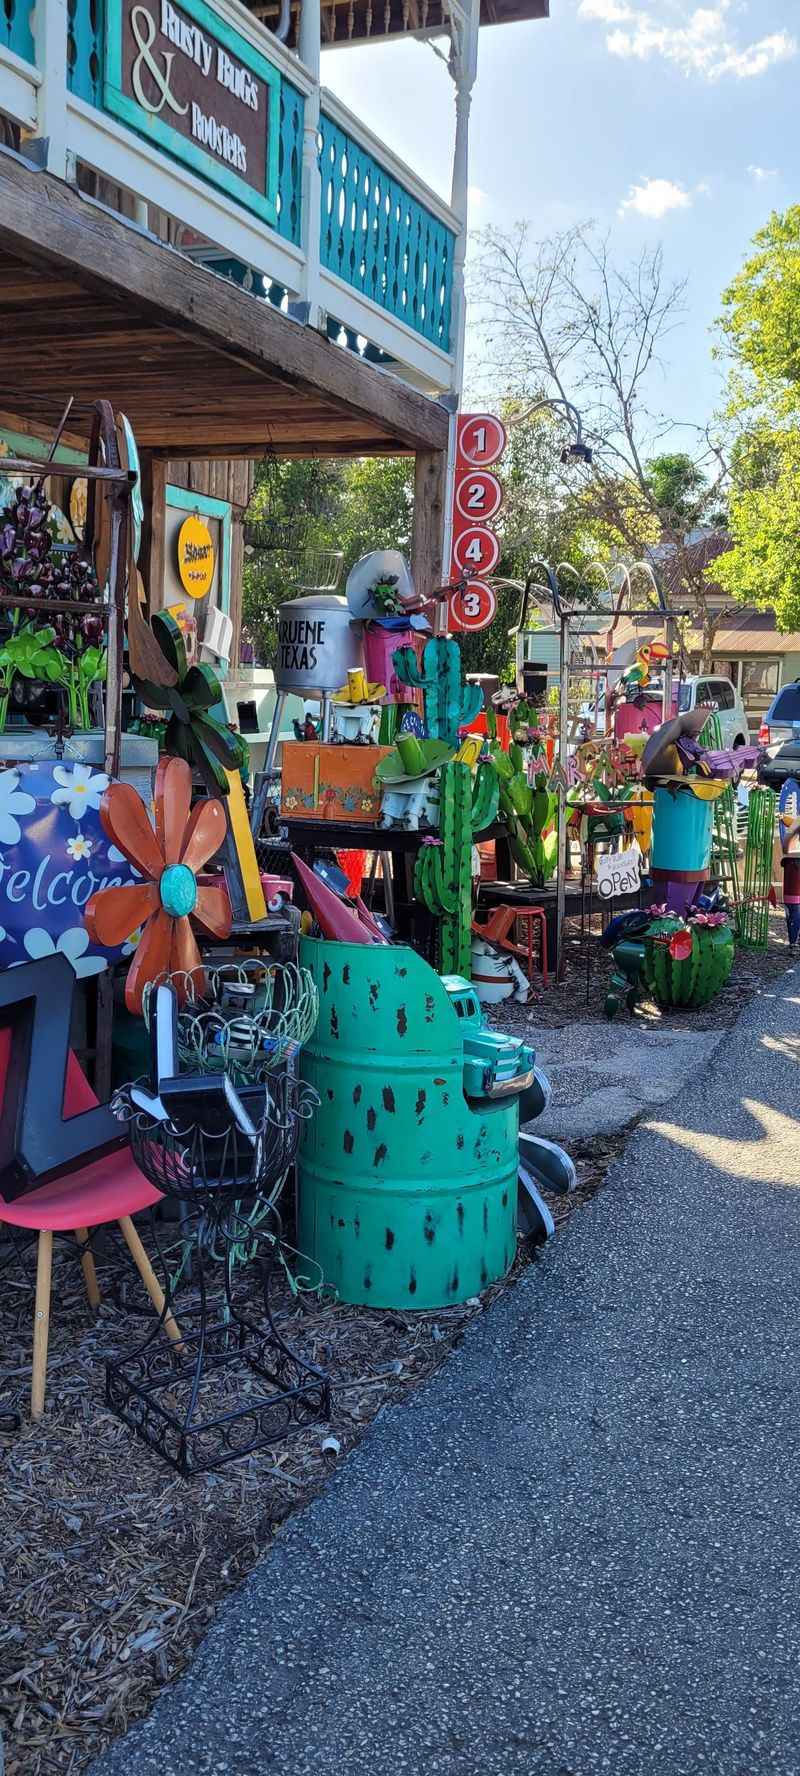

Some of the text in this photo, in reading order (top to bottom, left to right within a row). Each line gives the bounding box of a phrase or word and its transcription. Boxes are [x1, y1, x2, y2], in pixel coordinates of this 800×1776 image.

[131, 5, 189, 115] &
[473, 427, 486, 453] 1
[467, 484, 485, 508] 2
[465, 538, 483, 562] 4
[464, 593, 480, 616] 3
[281, 645, 317, 670] TEXAS
[0, 853, 136, 911] elco
